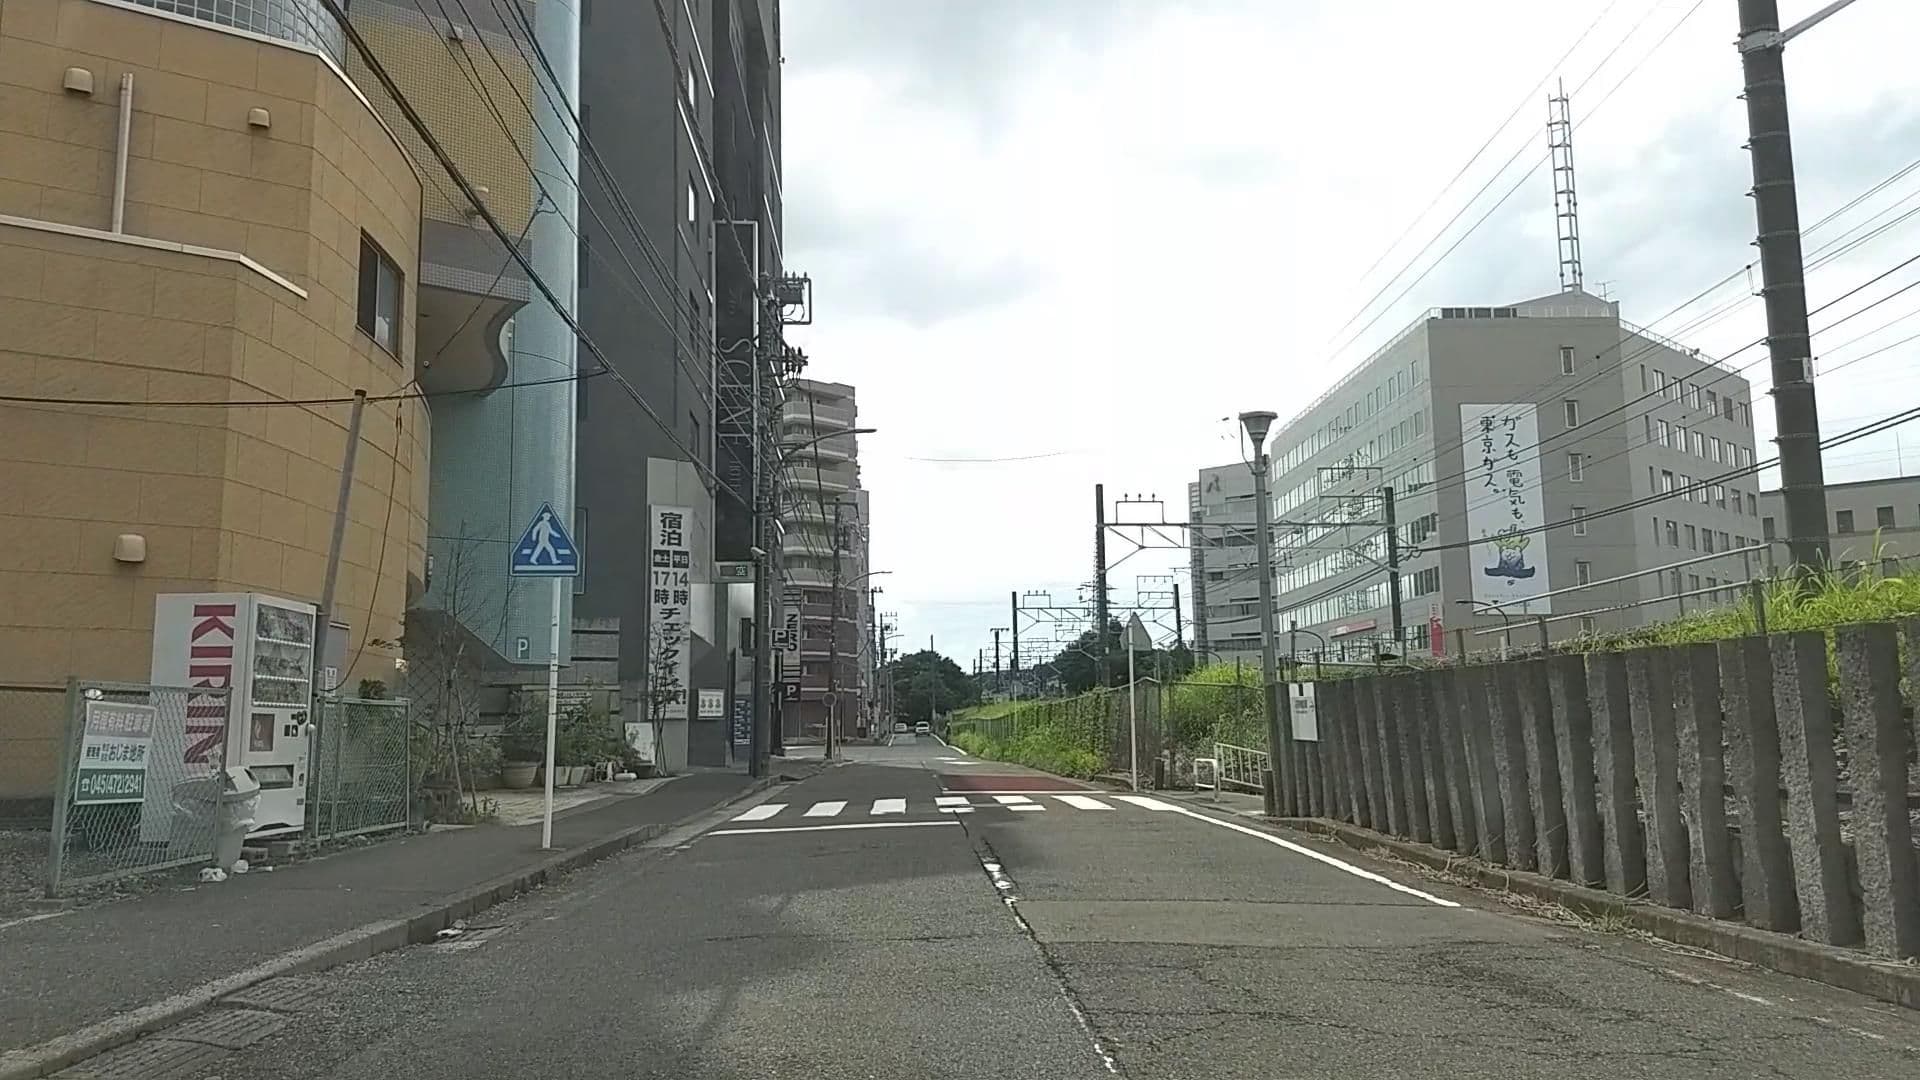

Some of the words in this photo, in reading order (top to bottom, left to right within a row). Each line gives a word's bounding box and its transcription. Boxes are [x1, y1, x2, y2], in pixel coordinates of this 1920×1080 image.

[660, 512, 682, 546] 宿泊
[774, 630, 787, 642] P
[517, 638, 528, 658] P
[184, 605, 236, 764] KIRIN
[786, 684, 797, 697] P
